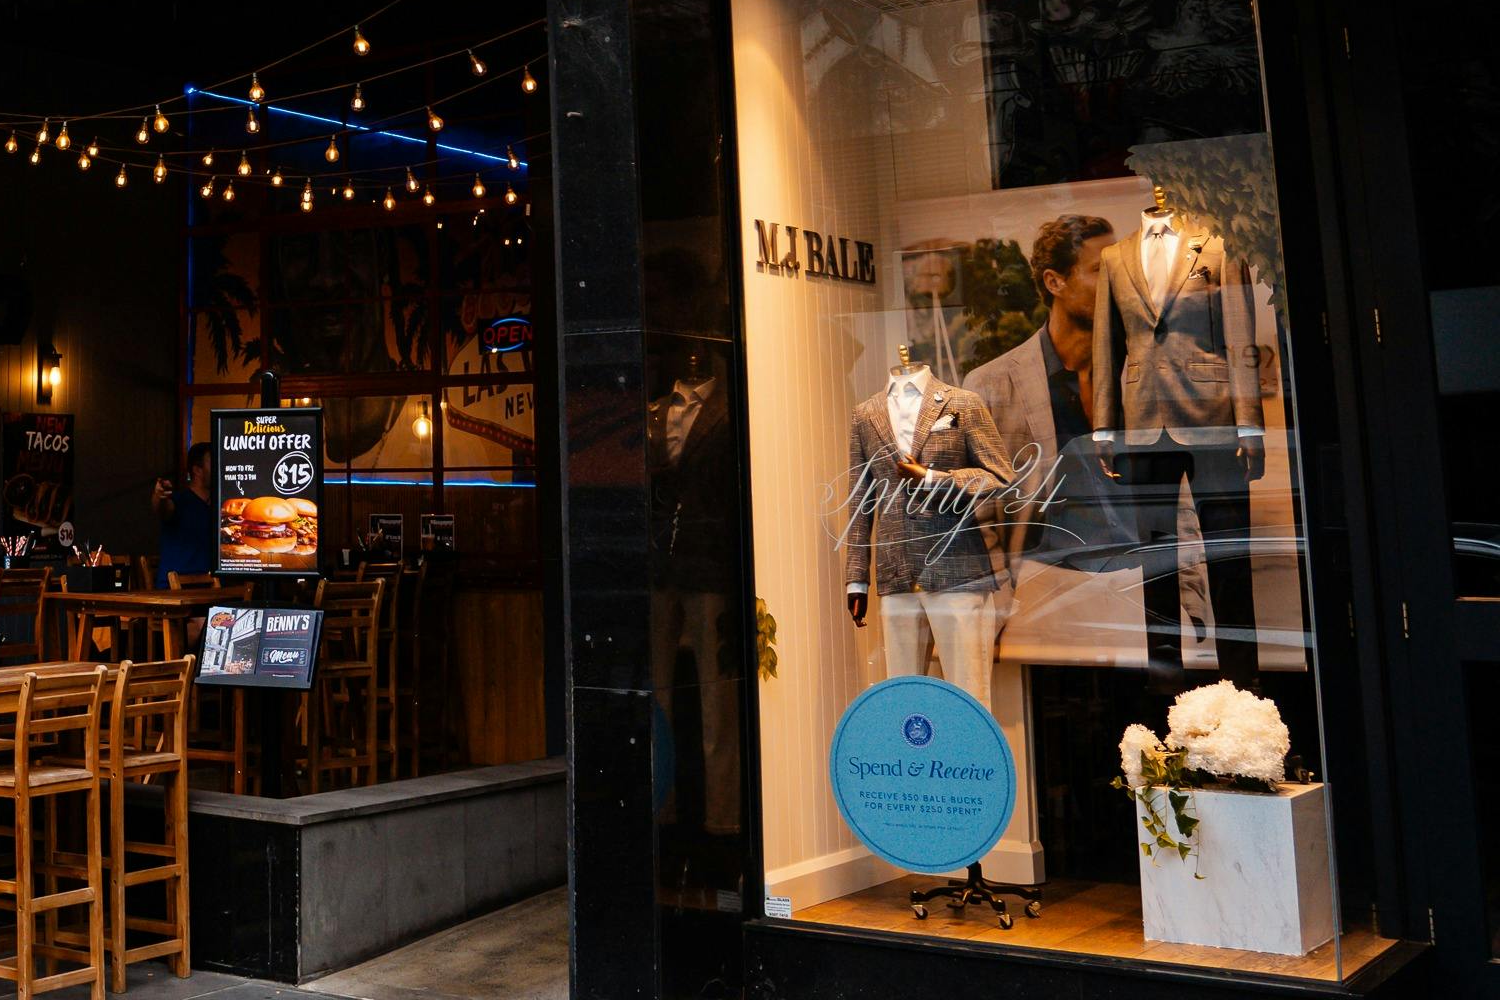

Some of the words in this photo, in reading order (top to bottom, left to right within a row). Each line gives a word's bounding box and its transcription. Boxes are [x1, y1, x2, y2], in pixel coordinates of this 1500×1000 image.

[803, 230, 876, 284] BALE
[483, 325, 533, 344] OPEN
[244, 421, 286, 435] Delicious
[255, 416, 277, 424] SUPER
[26, 431, 70, 453] TACOS
[223, 435, 265, 451] LUNCH
[269, 434, 312, 450] OFFER
[277, 462, 311, 487] $15
[818, 442, 997, 566] Spring
[997, 442, 1068, 514] 24
[60, 528, 73, 542] $16
[266, 614, 310, 633] BENNY'S
[270, 649, 300, 664] Menu
[849, 756, 902, 779] Spend
[907, 762, 925, 776] &
[929, 760, 995, 781] Receive
[859, 791, 899, 800] RECEIVE
[902, 793, 919, 802] $50
[923, 794, 946, 803] BALE
[950, 796, 983, 805] BUCKS
[865, 802, 883, 810] FOR
[887, 803, 916, 812] EVERY
[920, 804, 942, 813] $250
